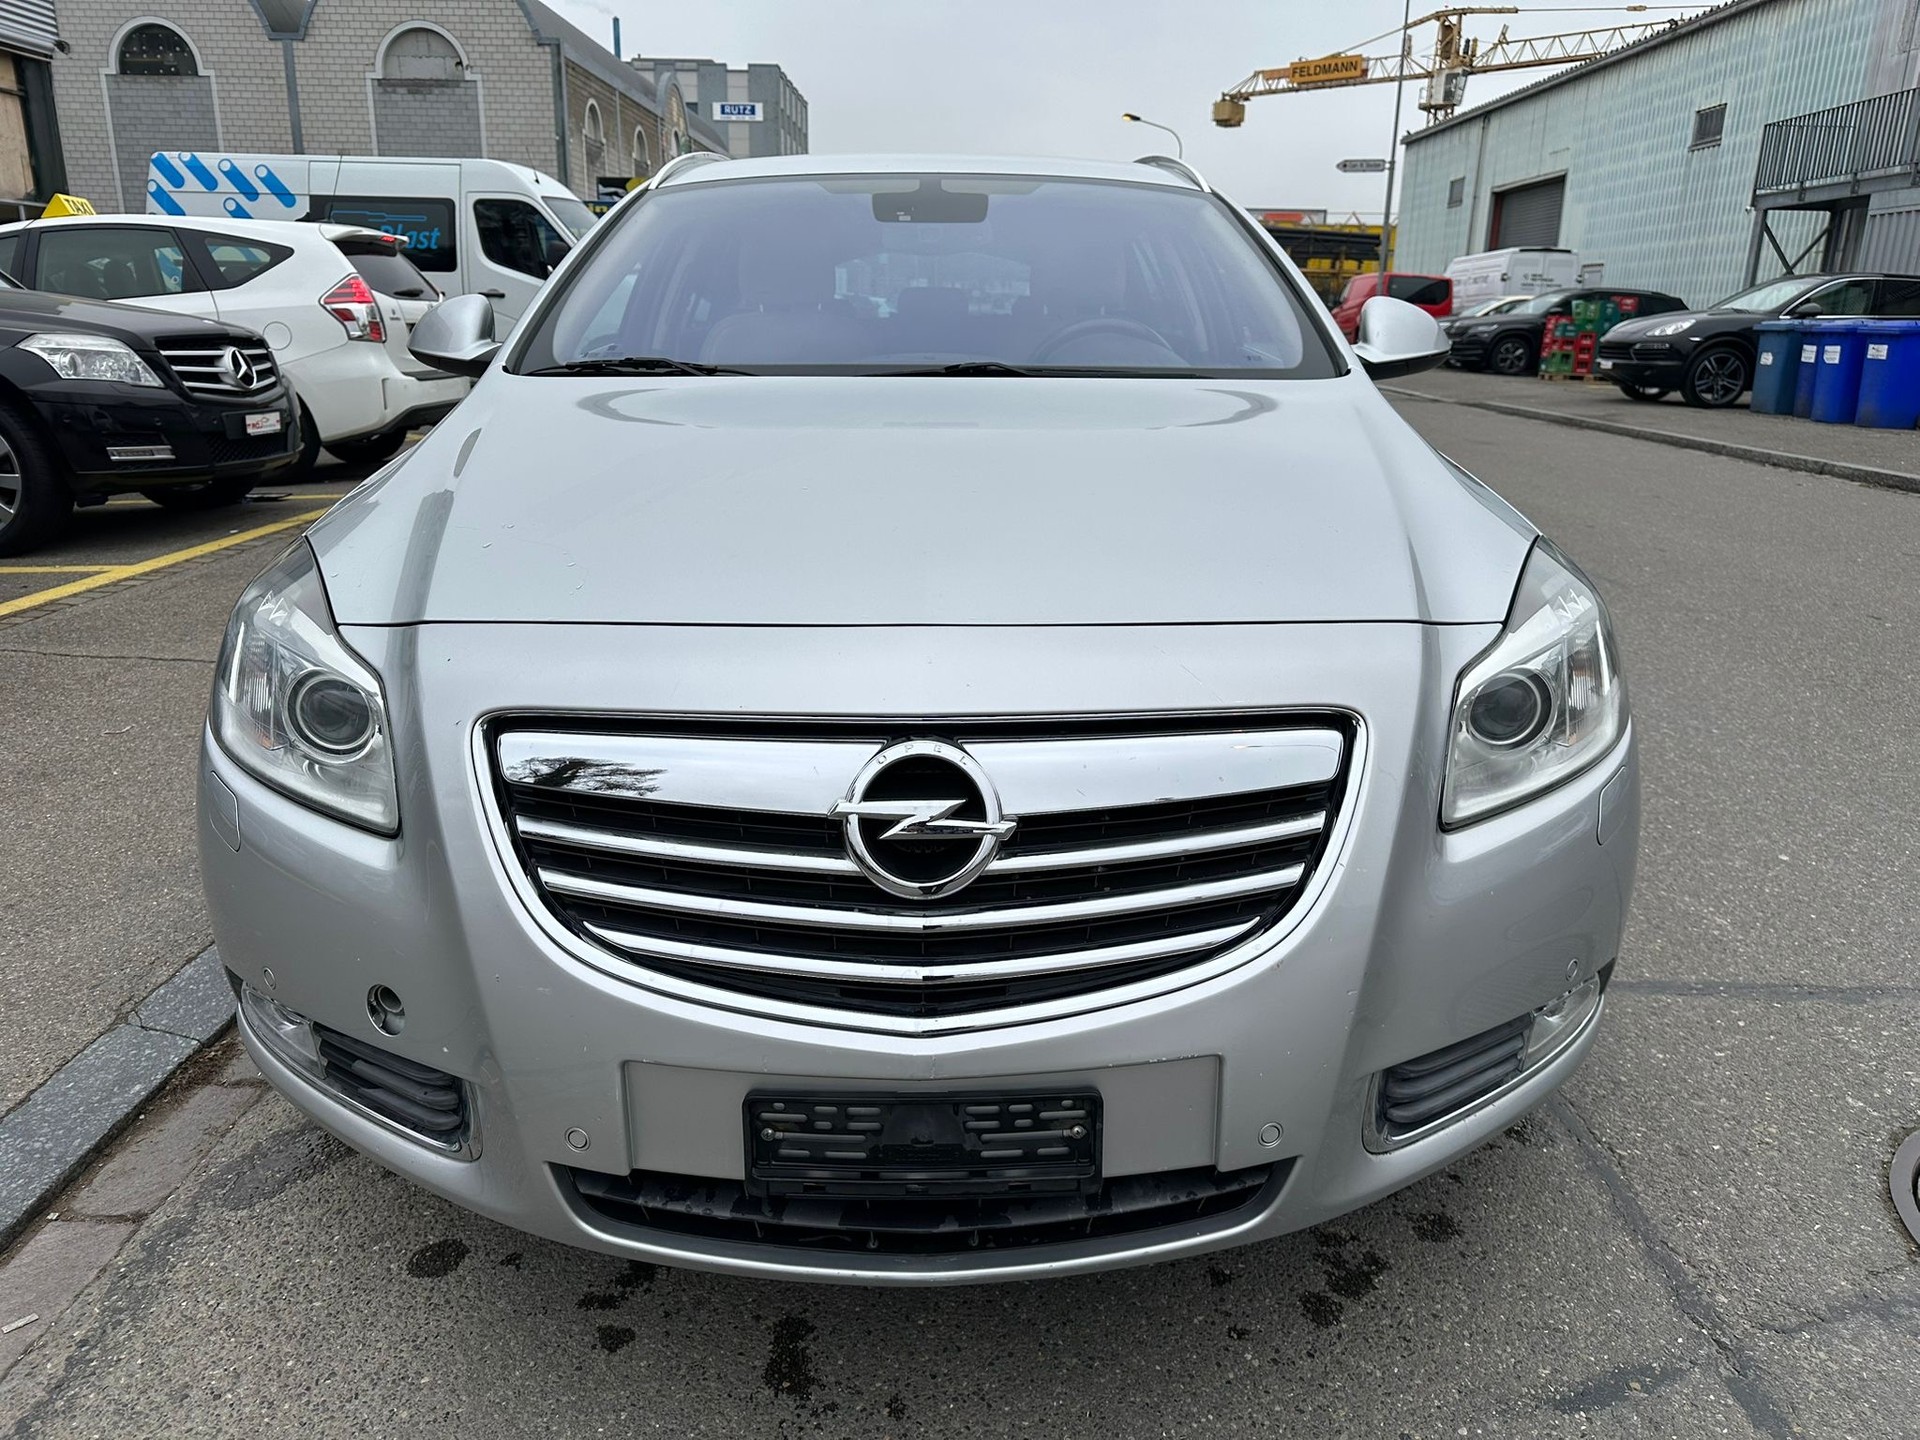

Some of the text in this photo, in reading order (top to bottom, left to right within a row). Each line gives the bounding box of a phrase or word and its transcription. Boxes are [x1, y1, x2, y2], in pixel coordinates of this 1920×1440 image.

[1291, 60, 1358, 78] FELDMANN
[724, 104, 752, 115] RUTZ
[63, 199, 94, 215] TAXI
[877, 744, 967, 766] OPEL
